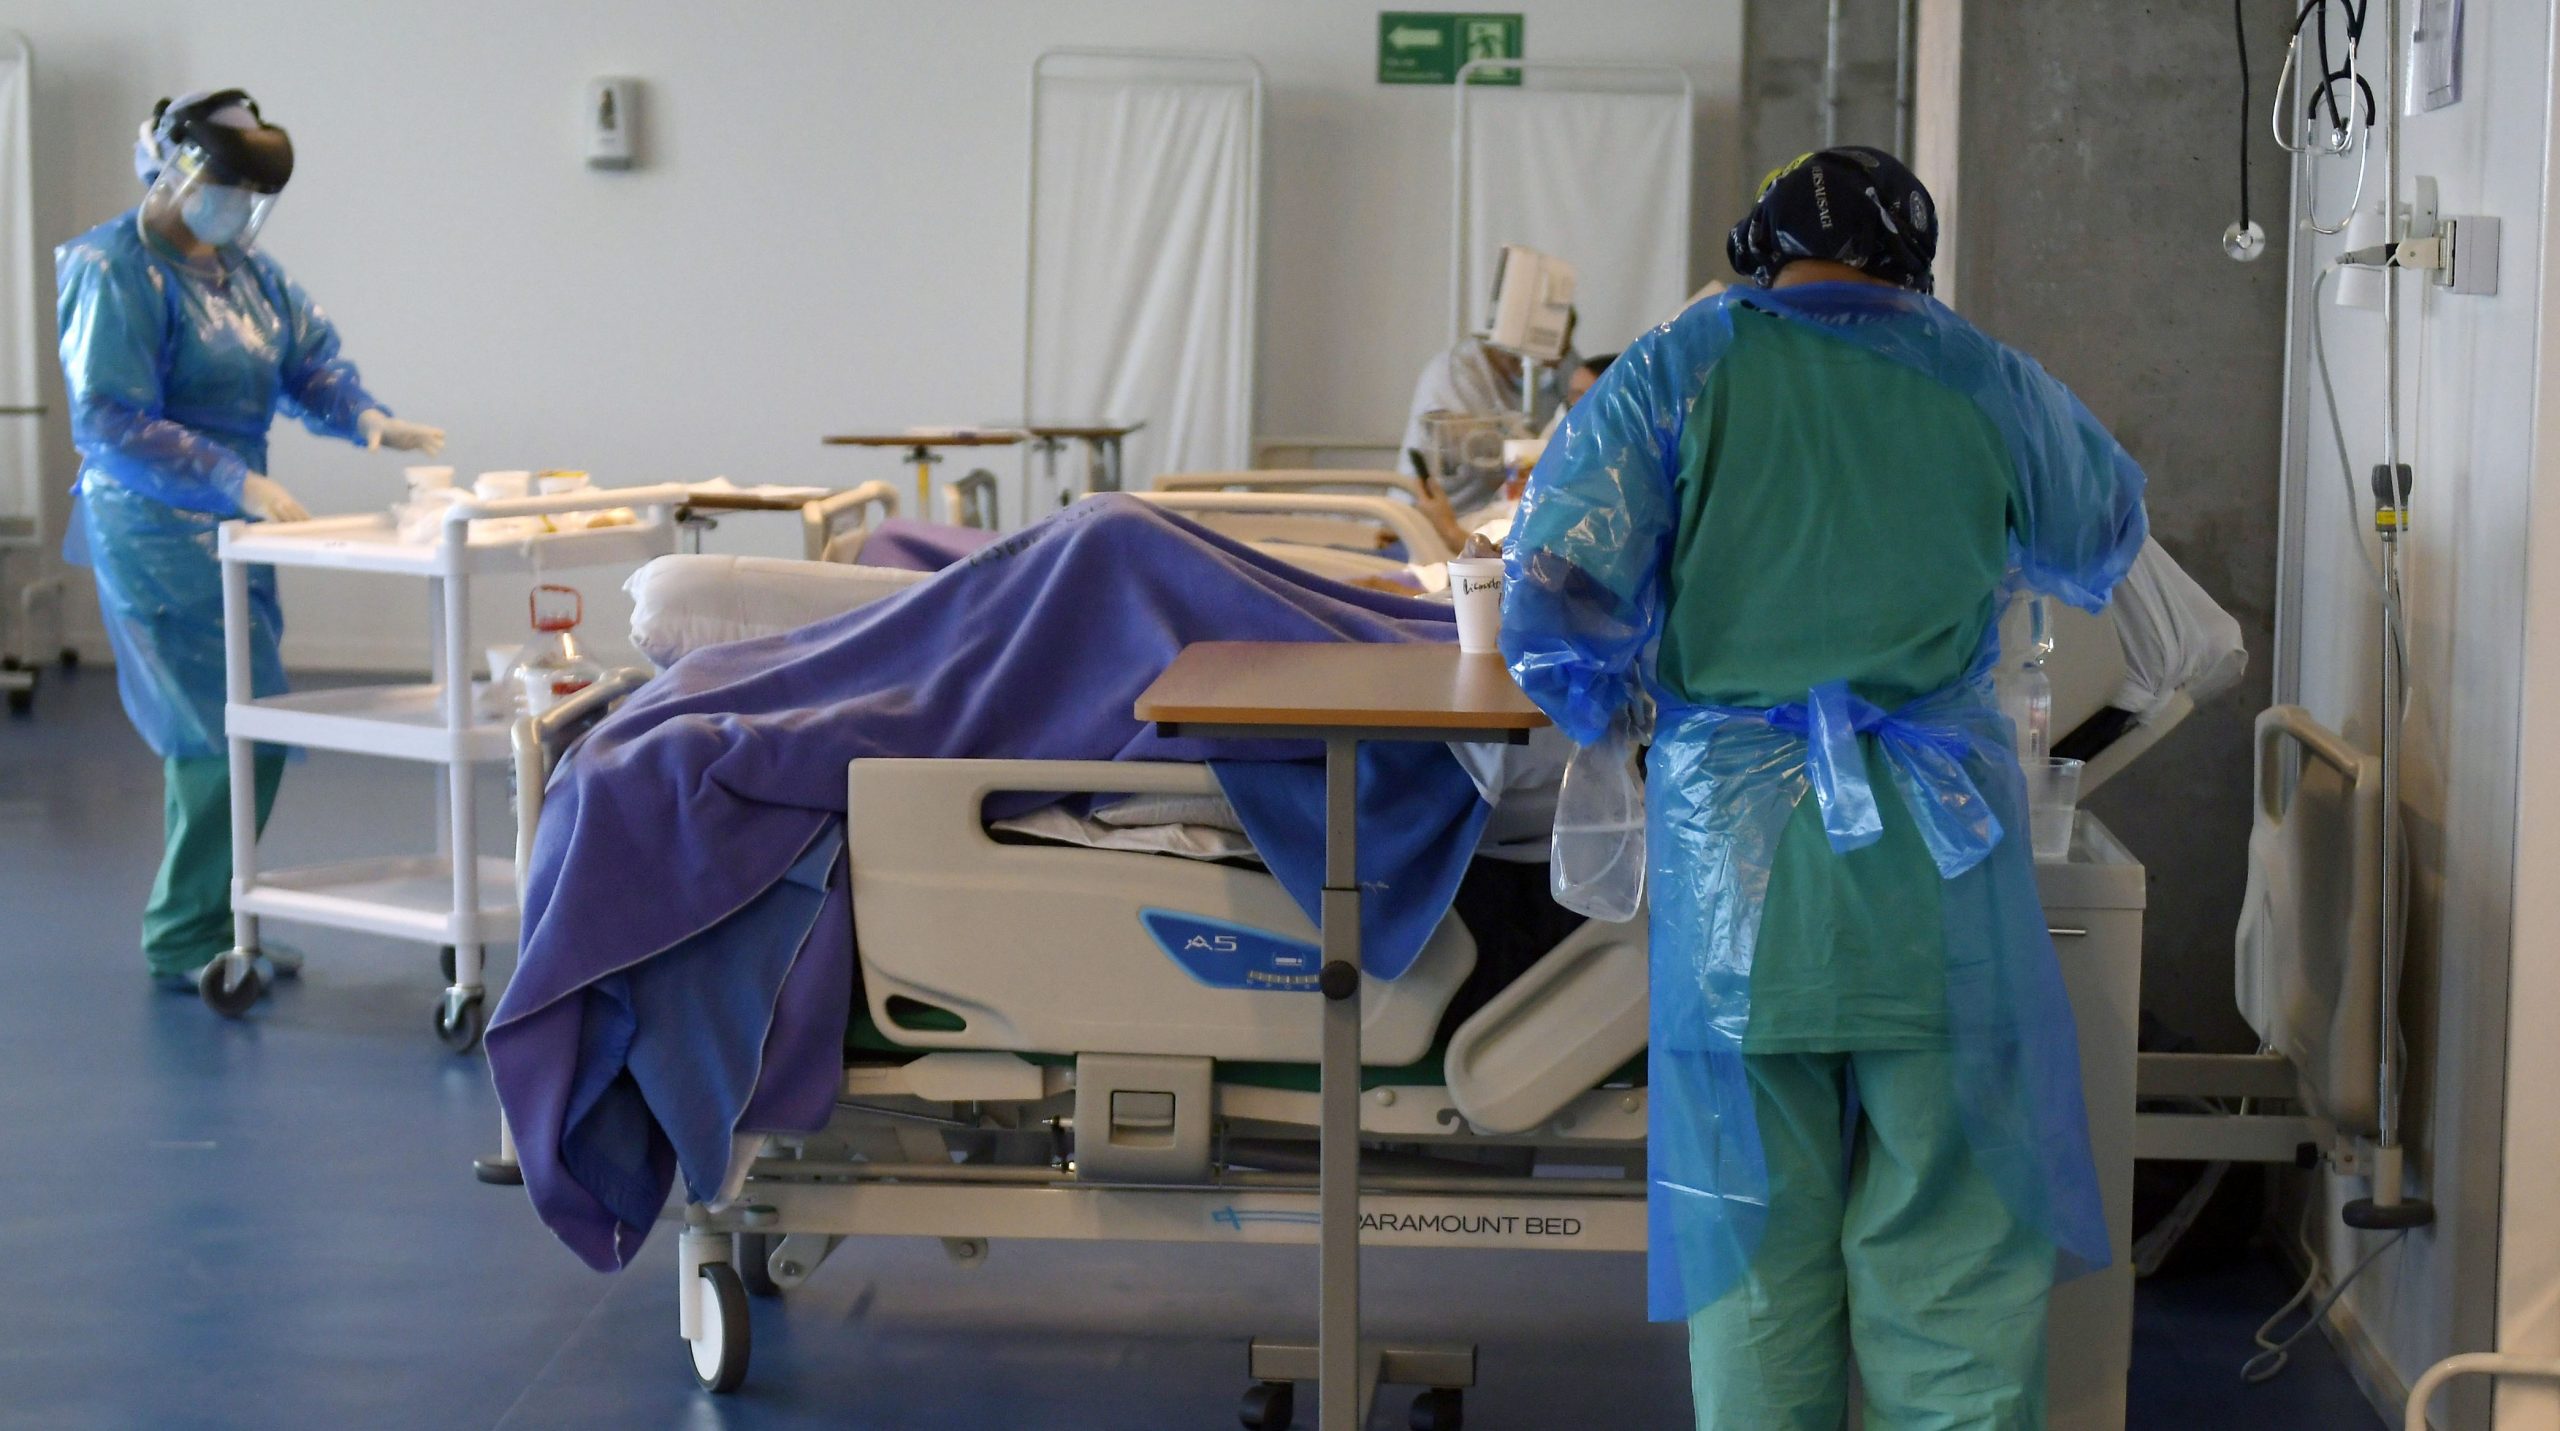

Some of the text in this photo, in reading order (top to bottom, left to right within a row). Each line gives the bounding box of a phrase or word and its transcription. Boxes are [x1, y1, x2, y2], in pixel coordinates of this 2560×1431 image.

[1184, 935, 1237, 951] A5
[1359, 1213, 1581, 1235] ARAMOUNT BED
